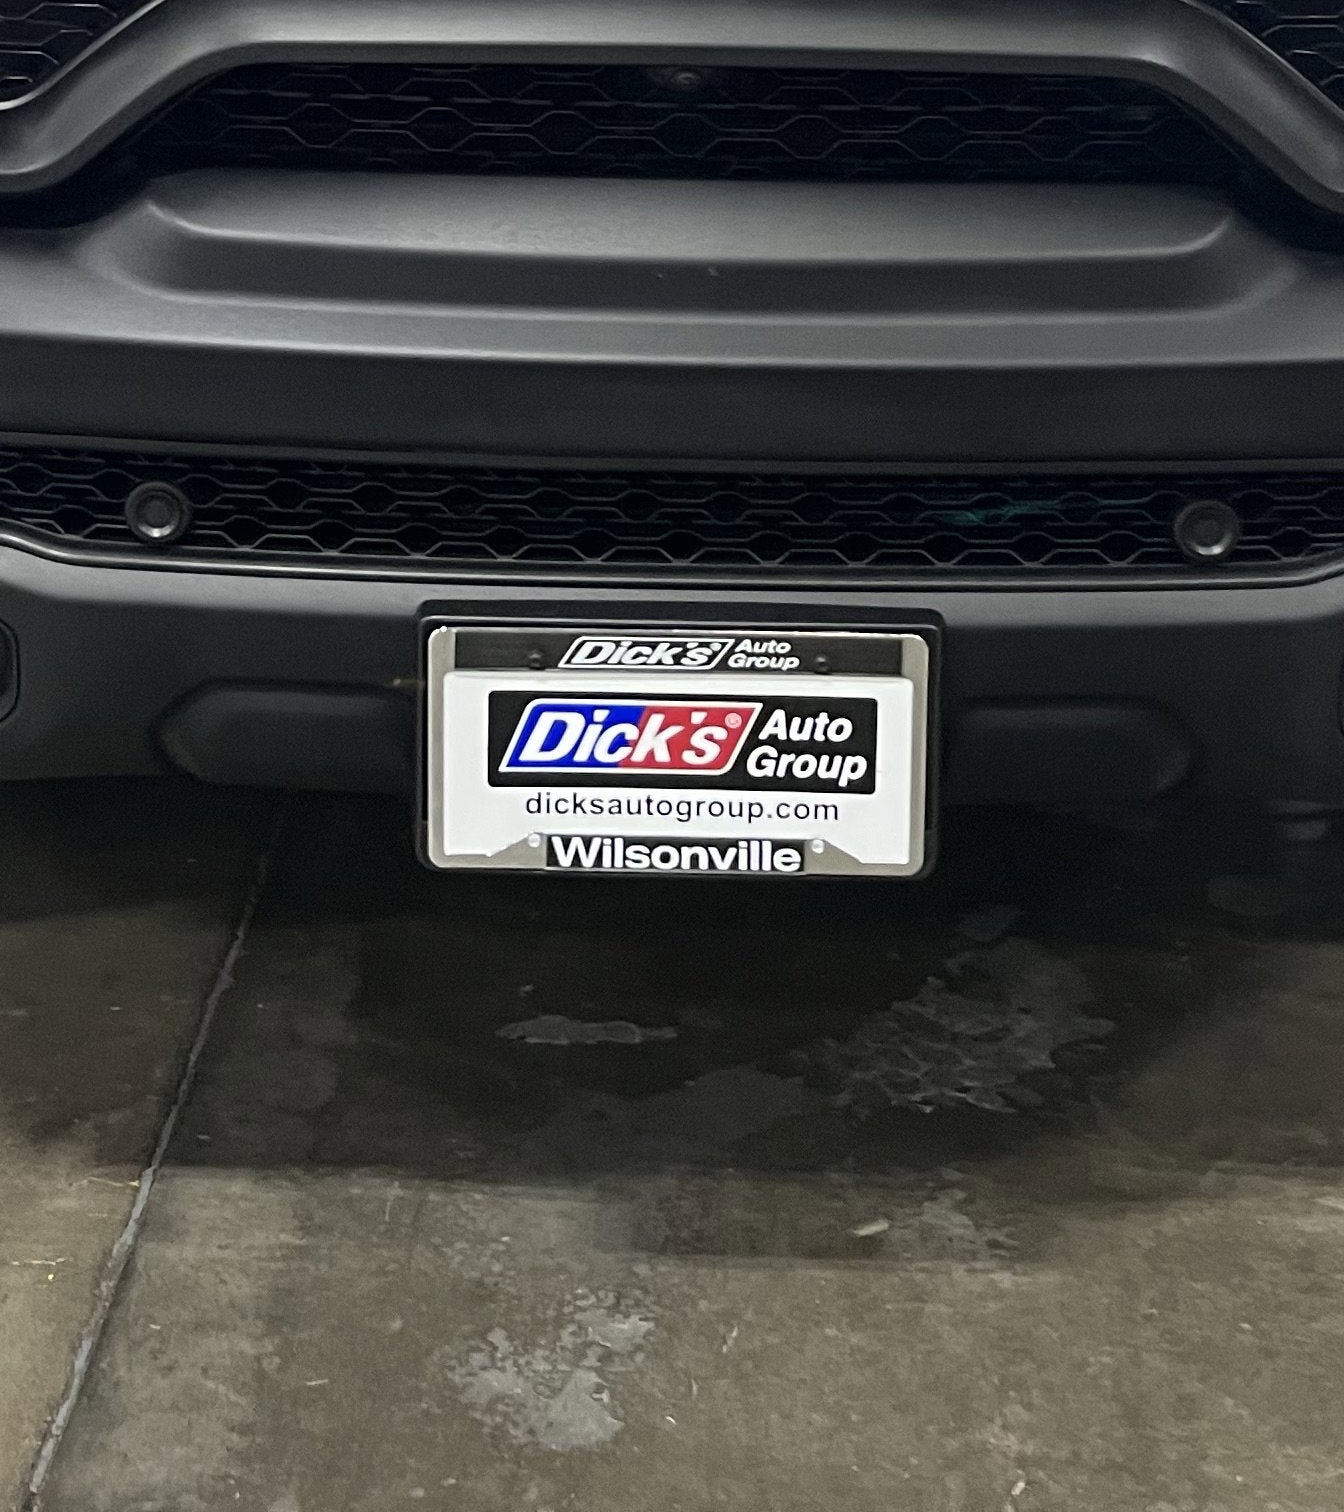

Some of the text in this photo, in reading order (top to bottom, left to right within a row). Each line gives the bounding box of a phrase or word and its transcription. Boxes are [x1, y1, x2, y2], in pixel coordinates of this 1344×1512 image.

[570, 638, 792, 667] Dick's Auto
[727, 653, 801, 671] Group
[518, 708, 854, 766] Dick's Auto
[746, 745, 868, 788] Group
[525, 792, 840, 824] dicksautogroup.com
[550, 835, 802, 873] Wilsonville
